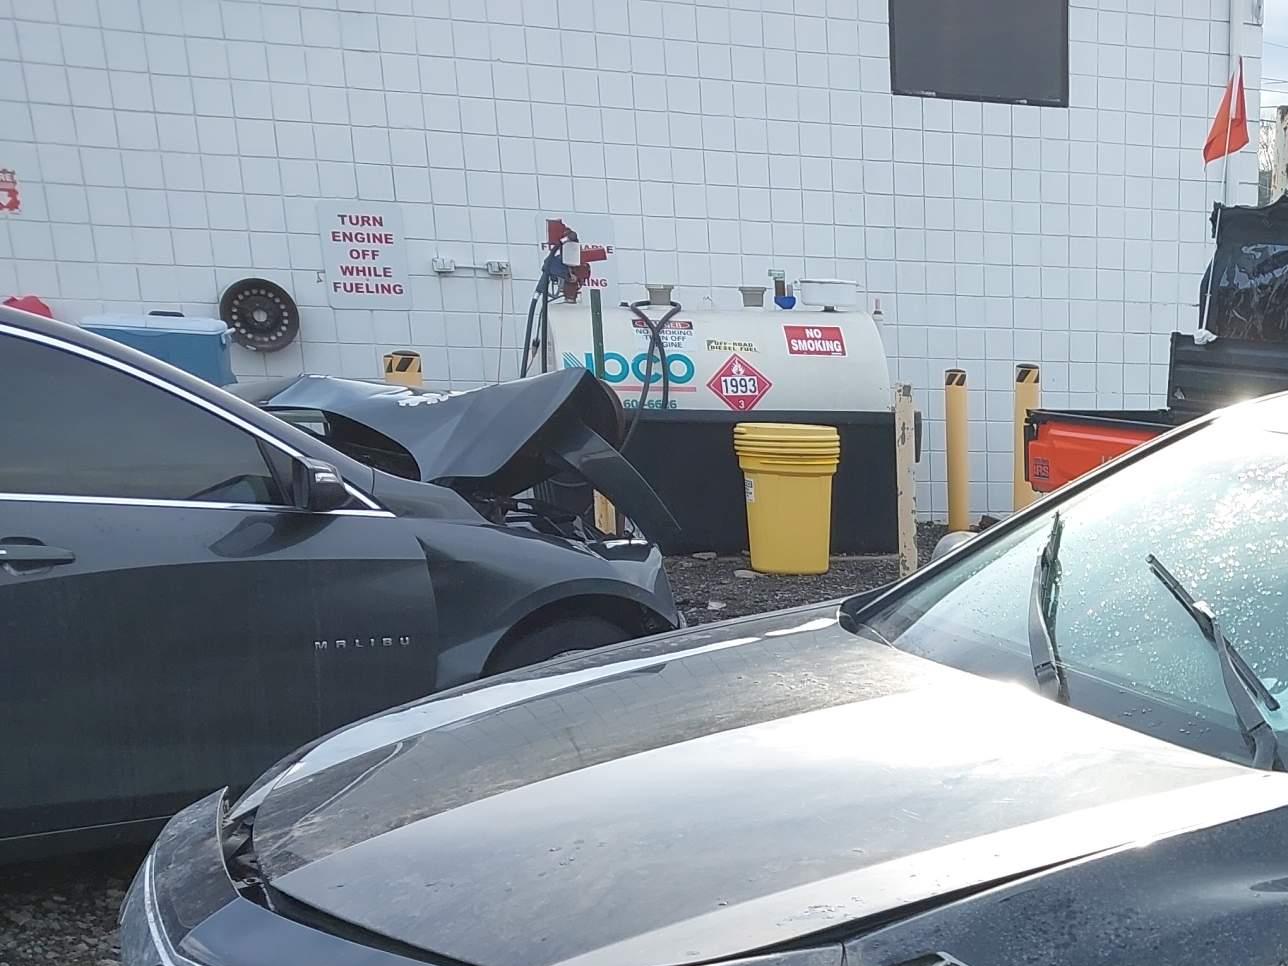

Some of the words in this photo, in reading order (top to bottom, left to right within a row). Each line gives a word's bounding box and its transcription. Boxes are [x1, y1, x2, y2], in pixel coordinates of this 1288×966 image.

[337, 214, 384, 227] TURN
[331, 231, 394, 244] ENGINE
[349, 249, 380, 260] OFF
[340, 265, 393, 278] WHILE
[333, 282, 404, 295] FUELING
[804, 328, 822, 338] NO
[790, 339, 842, 352] SMOKING
[723, 378, 757, 394] 1993
[738, 400, 745, 408] 3
[314, 636, 410, 649] MALIBU
